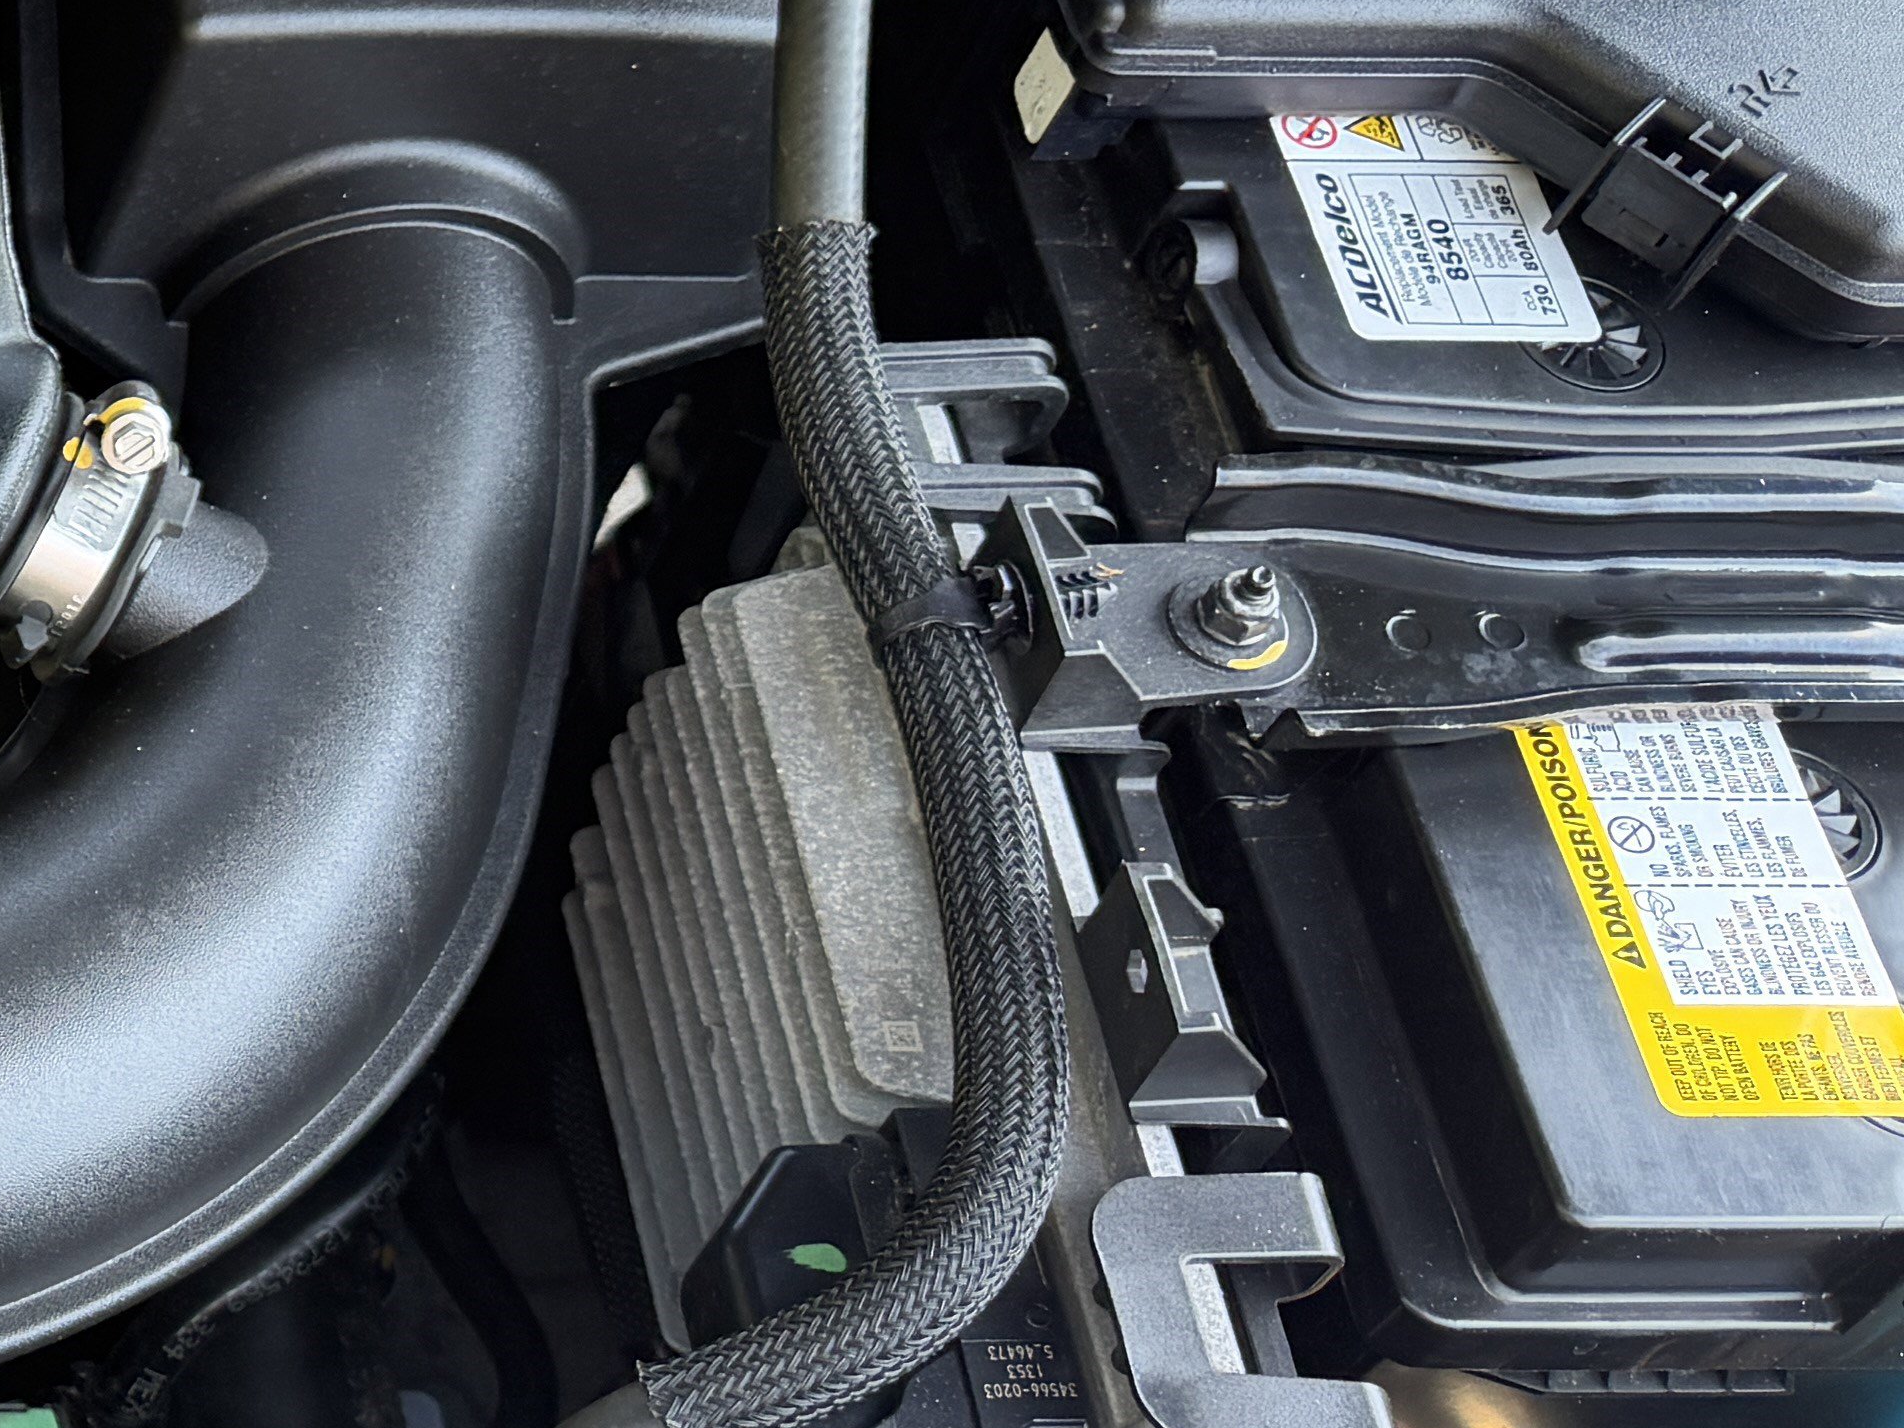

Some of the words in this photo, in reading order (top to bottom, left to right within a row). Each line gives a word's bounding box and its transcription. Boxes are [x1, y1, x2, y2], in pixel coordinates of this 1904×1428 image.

[1360, 195, 1385, 227] Model
[1490, 185, 1516, 215] 365
[1375, 191, 1410, 246] Rechange
[1315, 173, 1389, 318] ACDelco
[1399, 213, 1441, 284] 94RAGM
[1399, 249, 1414, 262] de
[1424, 219, 1470, 280] 8540
[1509, 229, 1539, 270] 80Ah
[1376, 232, 1416, 301] Replacement
[1531, 284, 1558, 315] 730
[1576, 747, 1612, 791] SULFURIC
[1608, 770, 1634, 791] ACID
[1527, 723, 1633, 938] DANGER/POISON
[1648, 863, 1671, 877] NO
[1752, 894, 1781, 920] YEUX
[1764, 923, 1789, 941] LES
[1667, 959, 1699, 994] SHIELD
[1694, 970, 1721, 994] EYES
[1707, 949, 1741, 994] EXPLOSIVE
[1736, 967, 1763, 994] GASES
[1006, 1363, 1043, 1379] 1353
[983, 1382, 1078, 1399] 34566-0203
